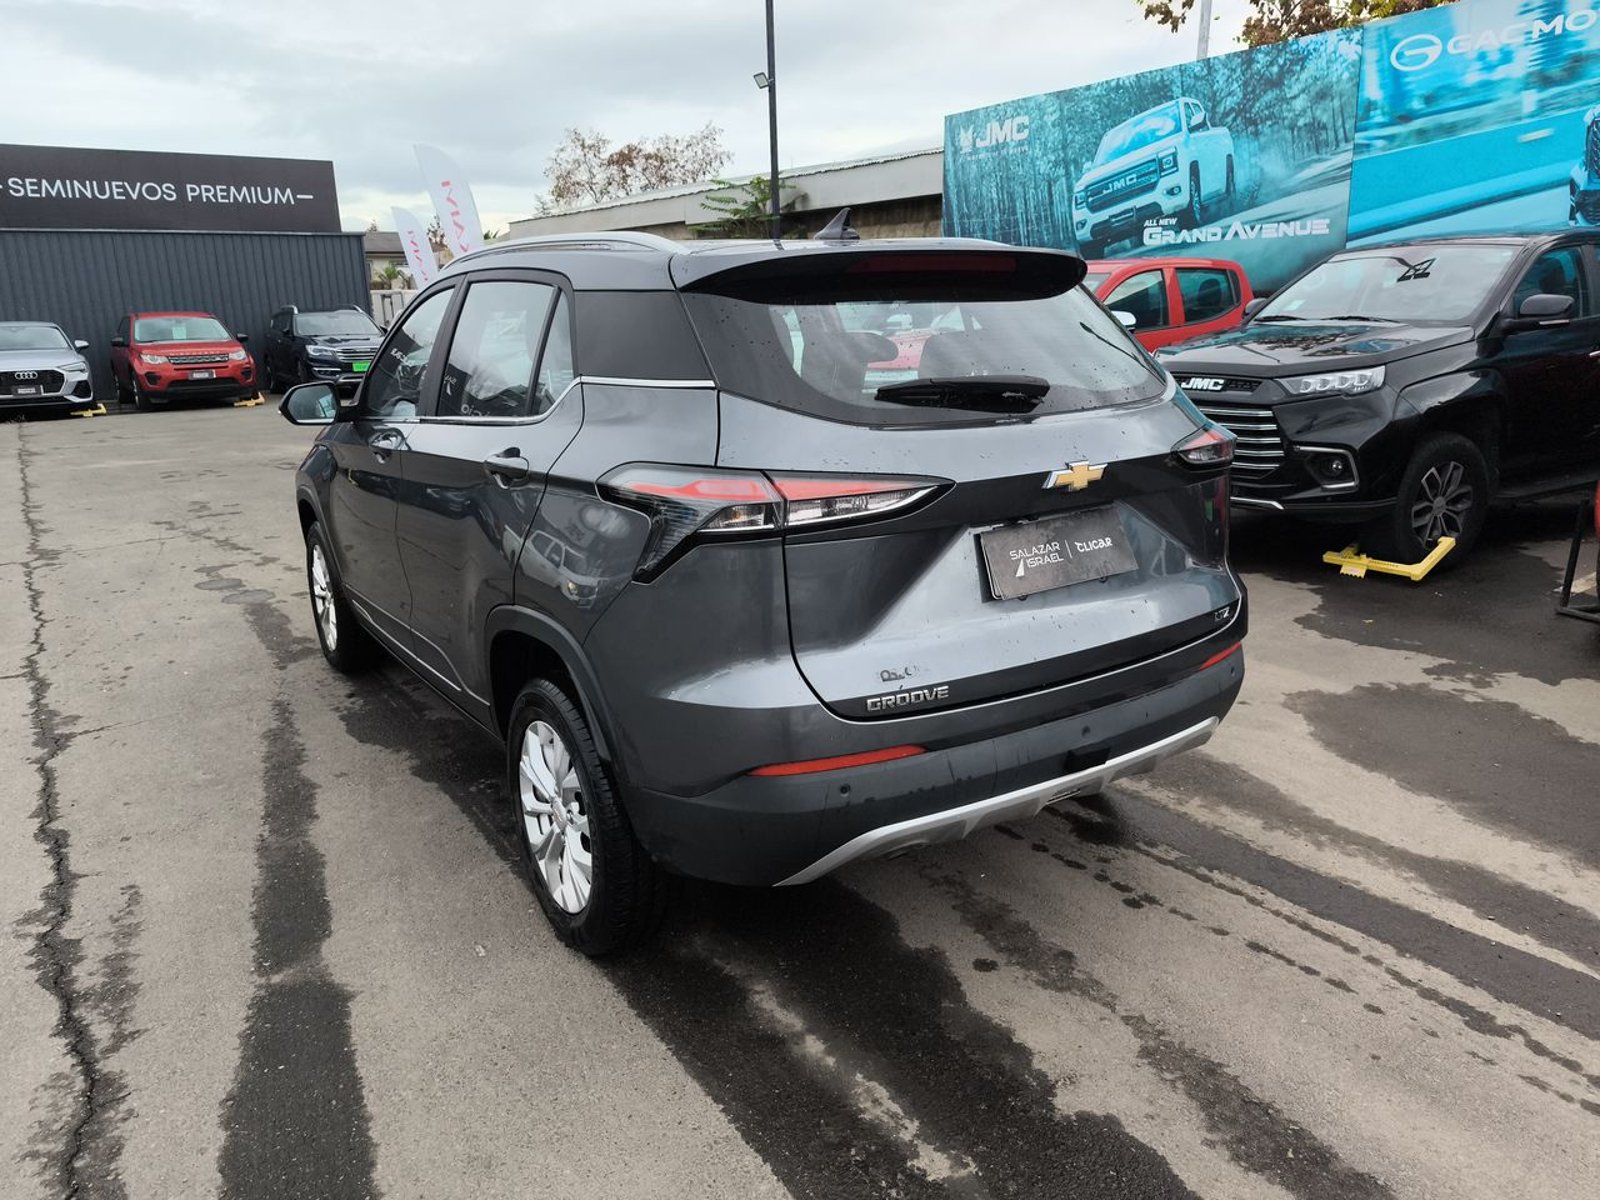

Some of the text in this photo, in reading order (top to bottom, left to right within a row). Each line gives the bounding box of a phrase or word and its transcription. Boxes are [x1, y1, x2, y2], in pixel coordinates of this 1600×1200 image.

[1447, 23, 1527, 54] GAC
[976, 115, 1029, 147] JMC
[8, 177, 295, 205] SEMINUEVOS PREMIUM
[1103, 173, 1137, 194] JMC
[1143, 217, 1178, 227] ALL NEW
[1143, 219, 1330, 245] GRAND AVENUE
[1181, 377, 1224, 390] JMC
[1009, 541, 1061, 560] SALAZAR
[1026, 553, 1064, 568] ISRAEL
[866, 685, 949, 711] GROOVE
